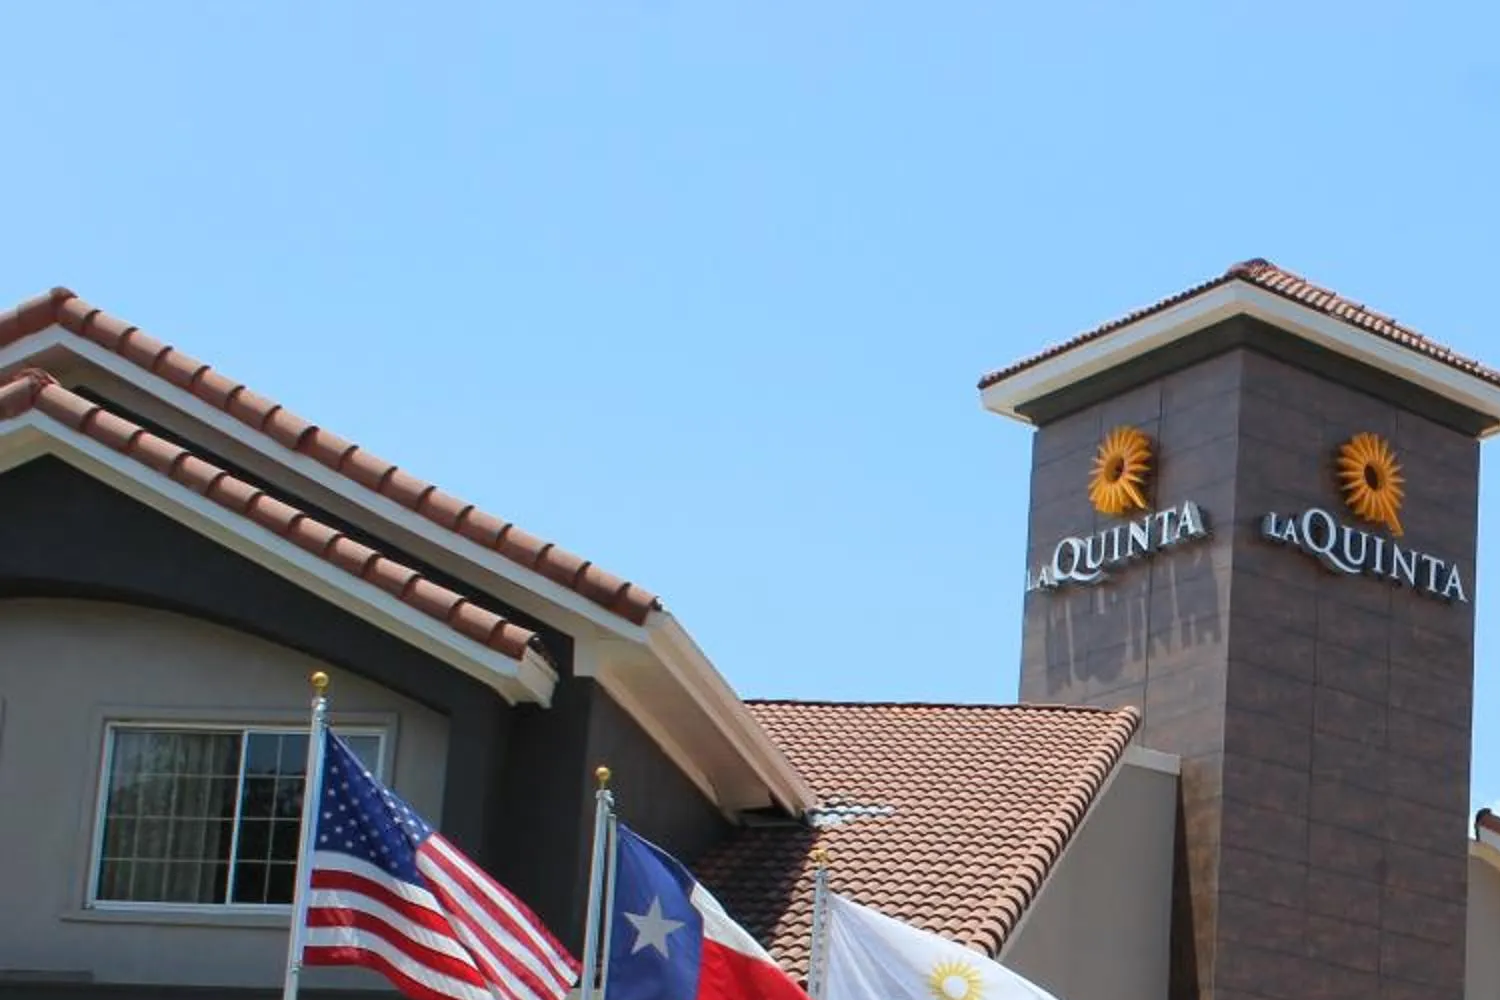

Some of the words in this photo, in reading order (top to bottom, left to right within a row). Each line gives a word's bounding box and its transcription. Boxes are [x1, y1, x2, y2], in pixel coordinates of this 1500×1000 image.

[1026, 567, 1056, 592] LA
[1052, 500, 1205, 582] QUINTA
[1267, 511, 1300, 545] LA
[1301, 508, 1468, 602] QUINTA
